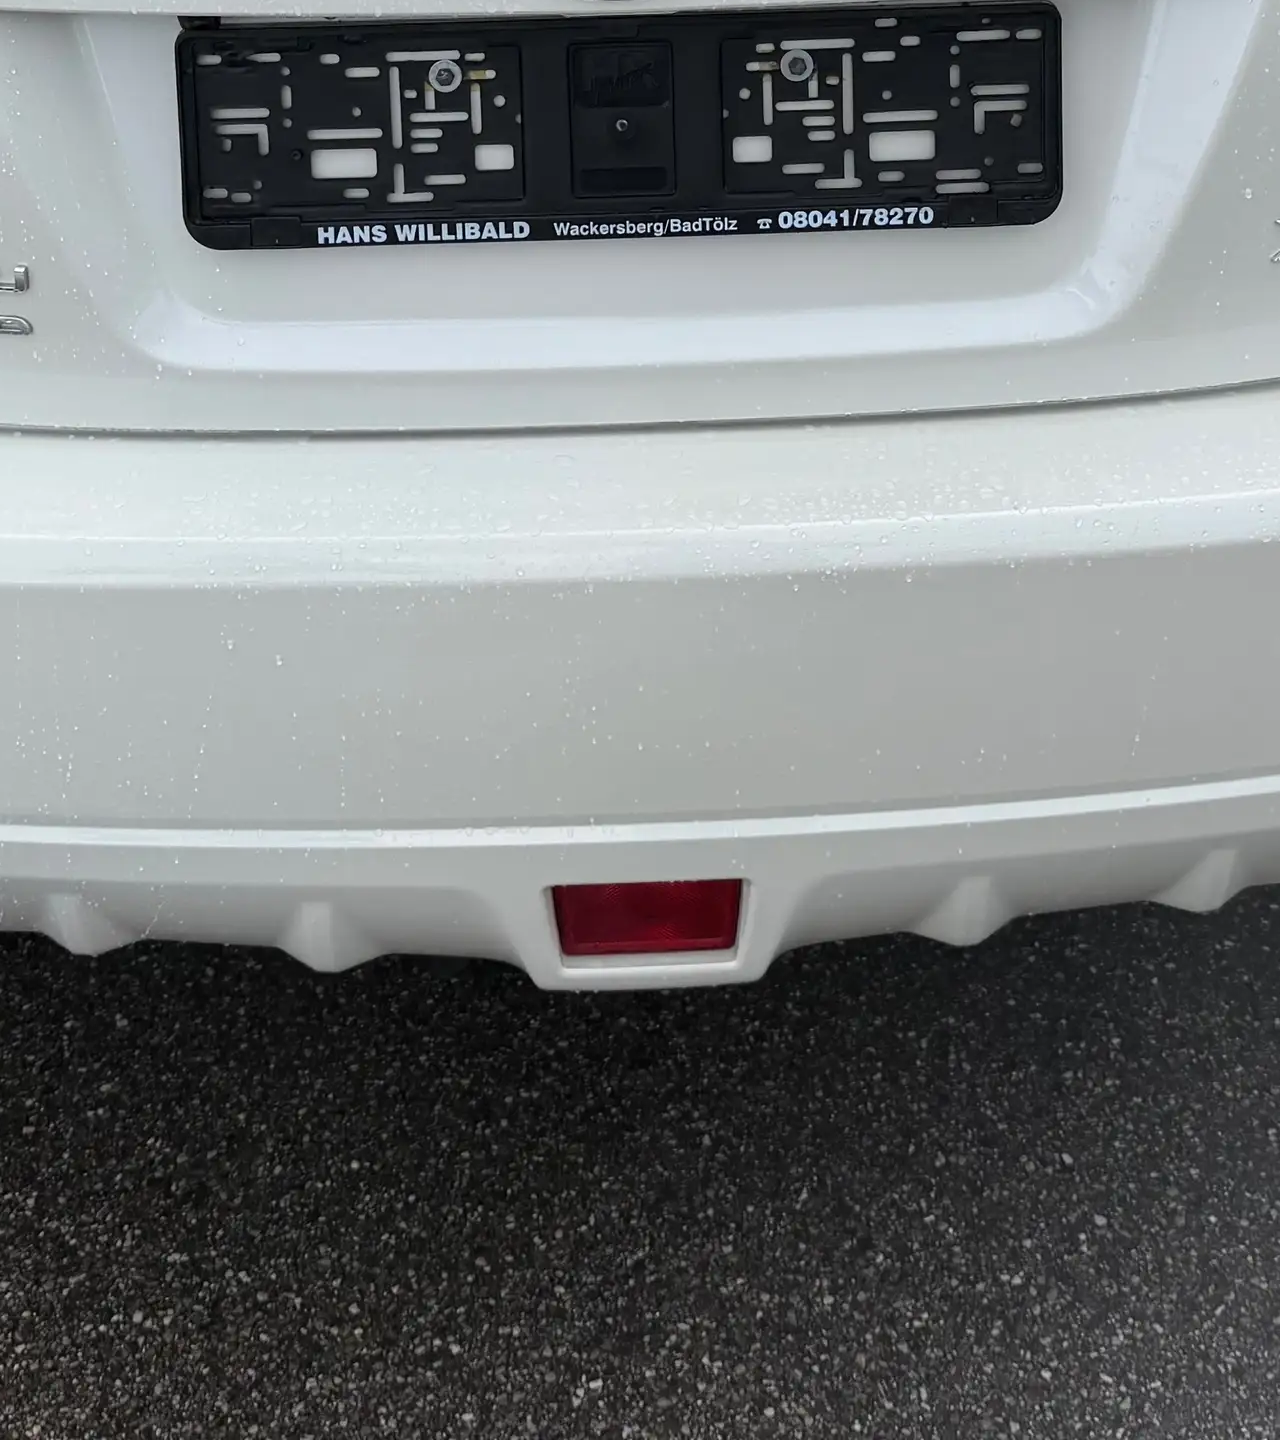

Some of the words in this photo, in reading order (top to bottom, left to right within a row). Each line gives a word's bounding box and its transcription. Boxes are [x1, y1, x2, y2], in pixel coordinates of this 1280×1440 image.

[317, 224, 388, 244] HANS
[395, 221, 531, 242] WILLIBALD
[778, 206, 934, 229] 08041/78270
